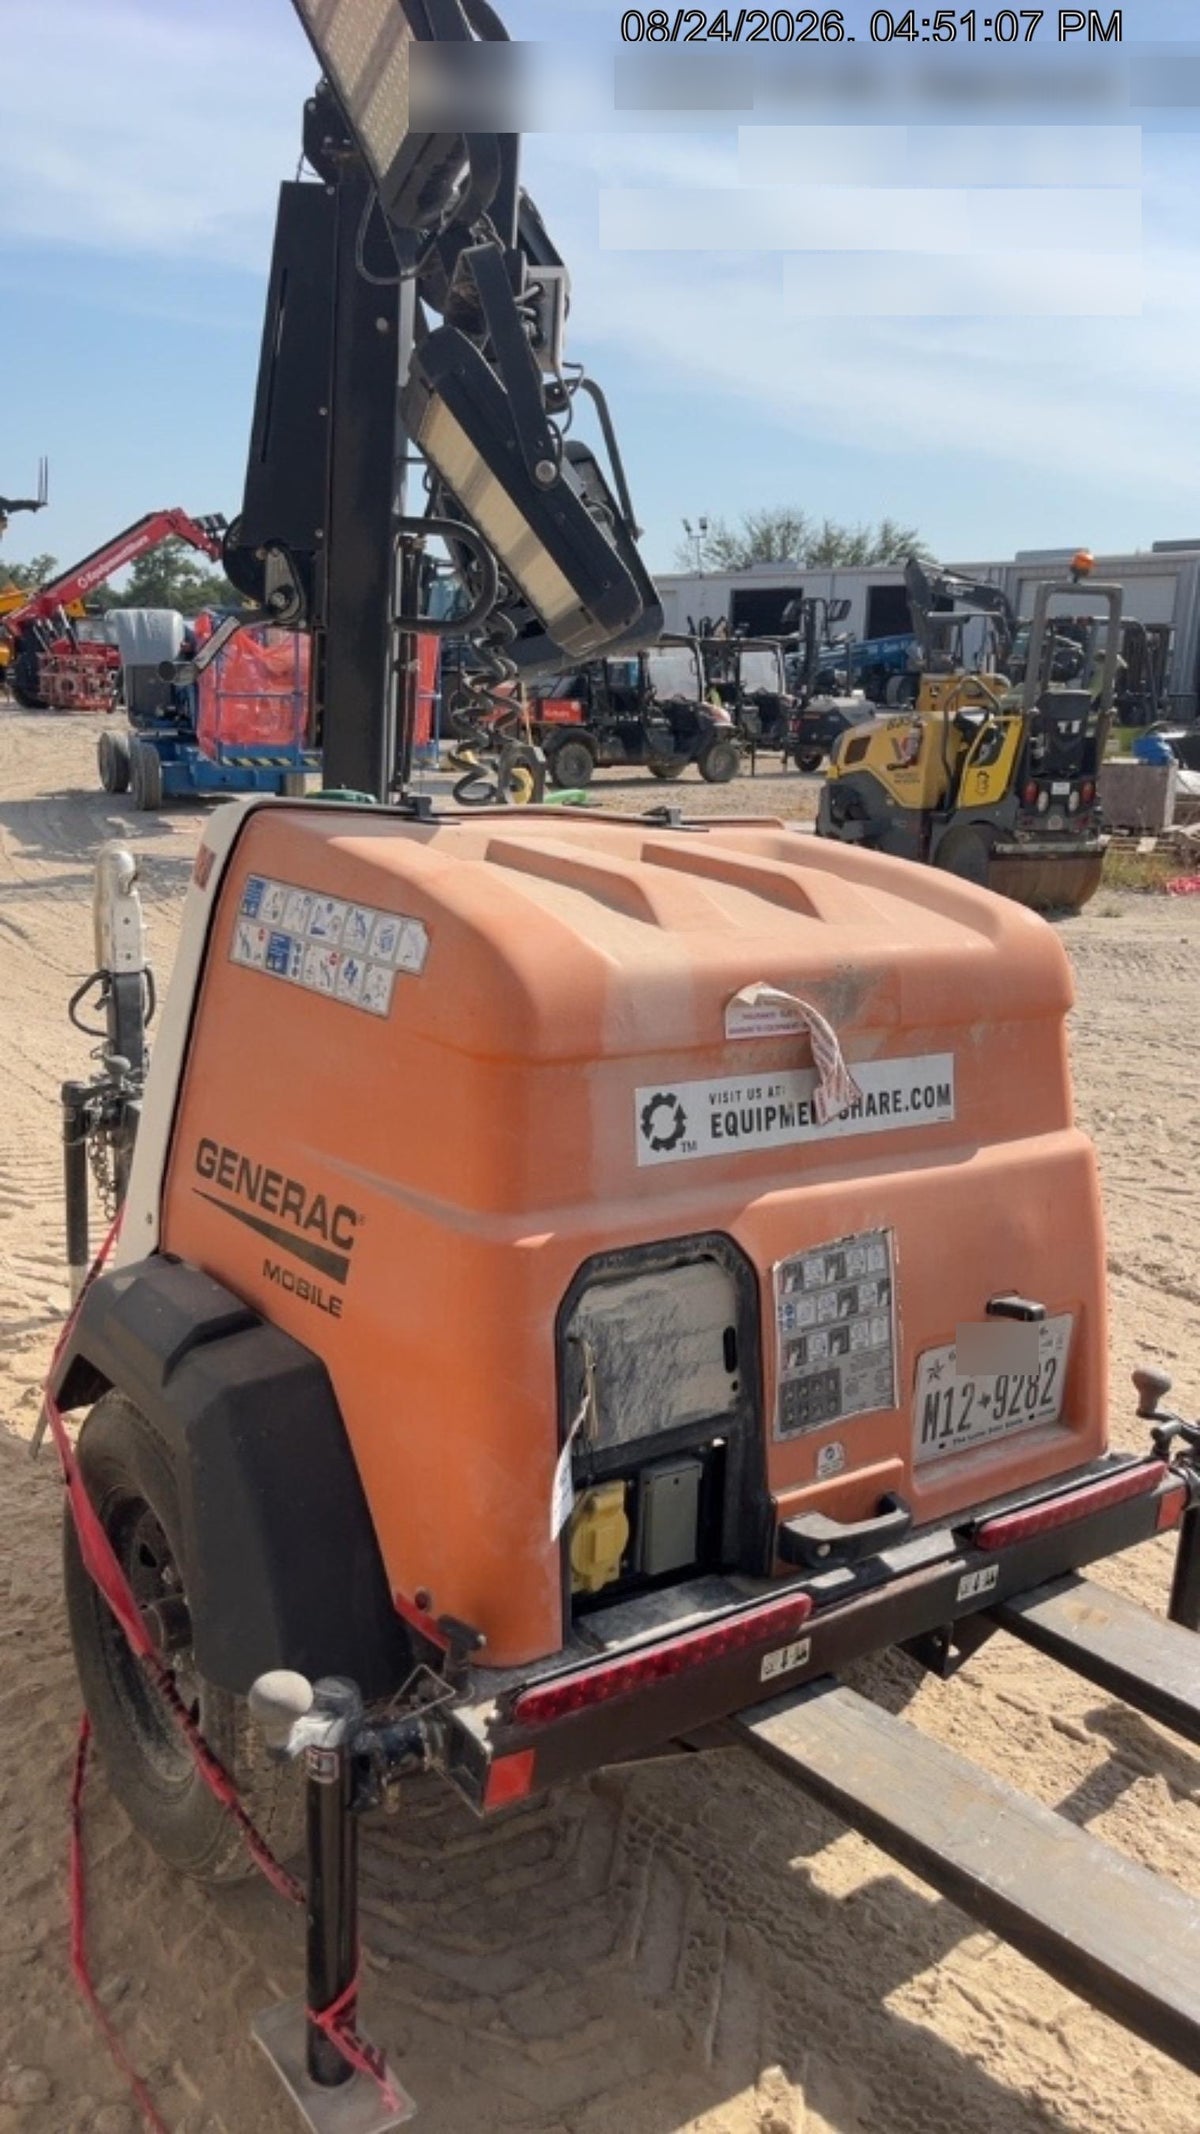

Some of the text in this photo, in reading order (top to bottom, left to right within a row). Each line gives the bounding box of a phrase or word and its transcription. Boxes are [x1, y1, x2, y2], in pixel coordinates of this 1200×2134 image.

[709, 1086, 786, 1105] VISIT US AT:
[710, 1083, 951, 1139] EQUIPMEHARE.COM
[195, 1137, 358, 1251] GENERAC
[262, 1259, 343, 1319] MOBILE
